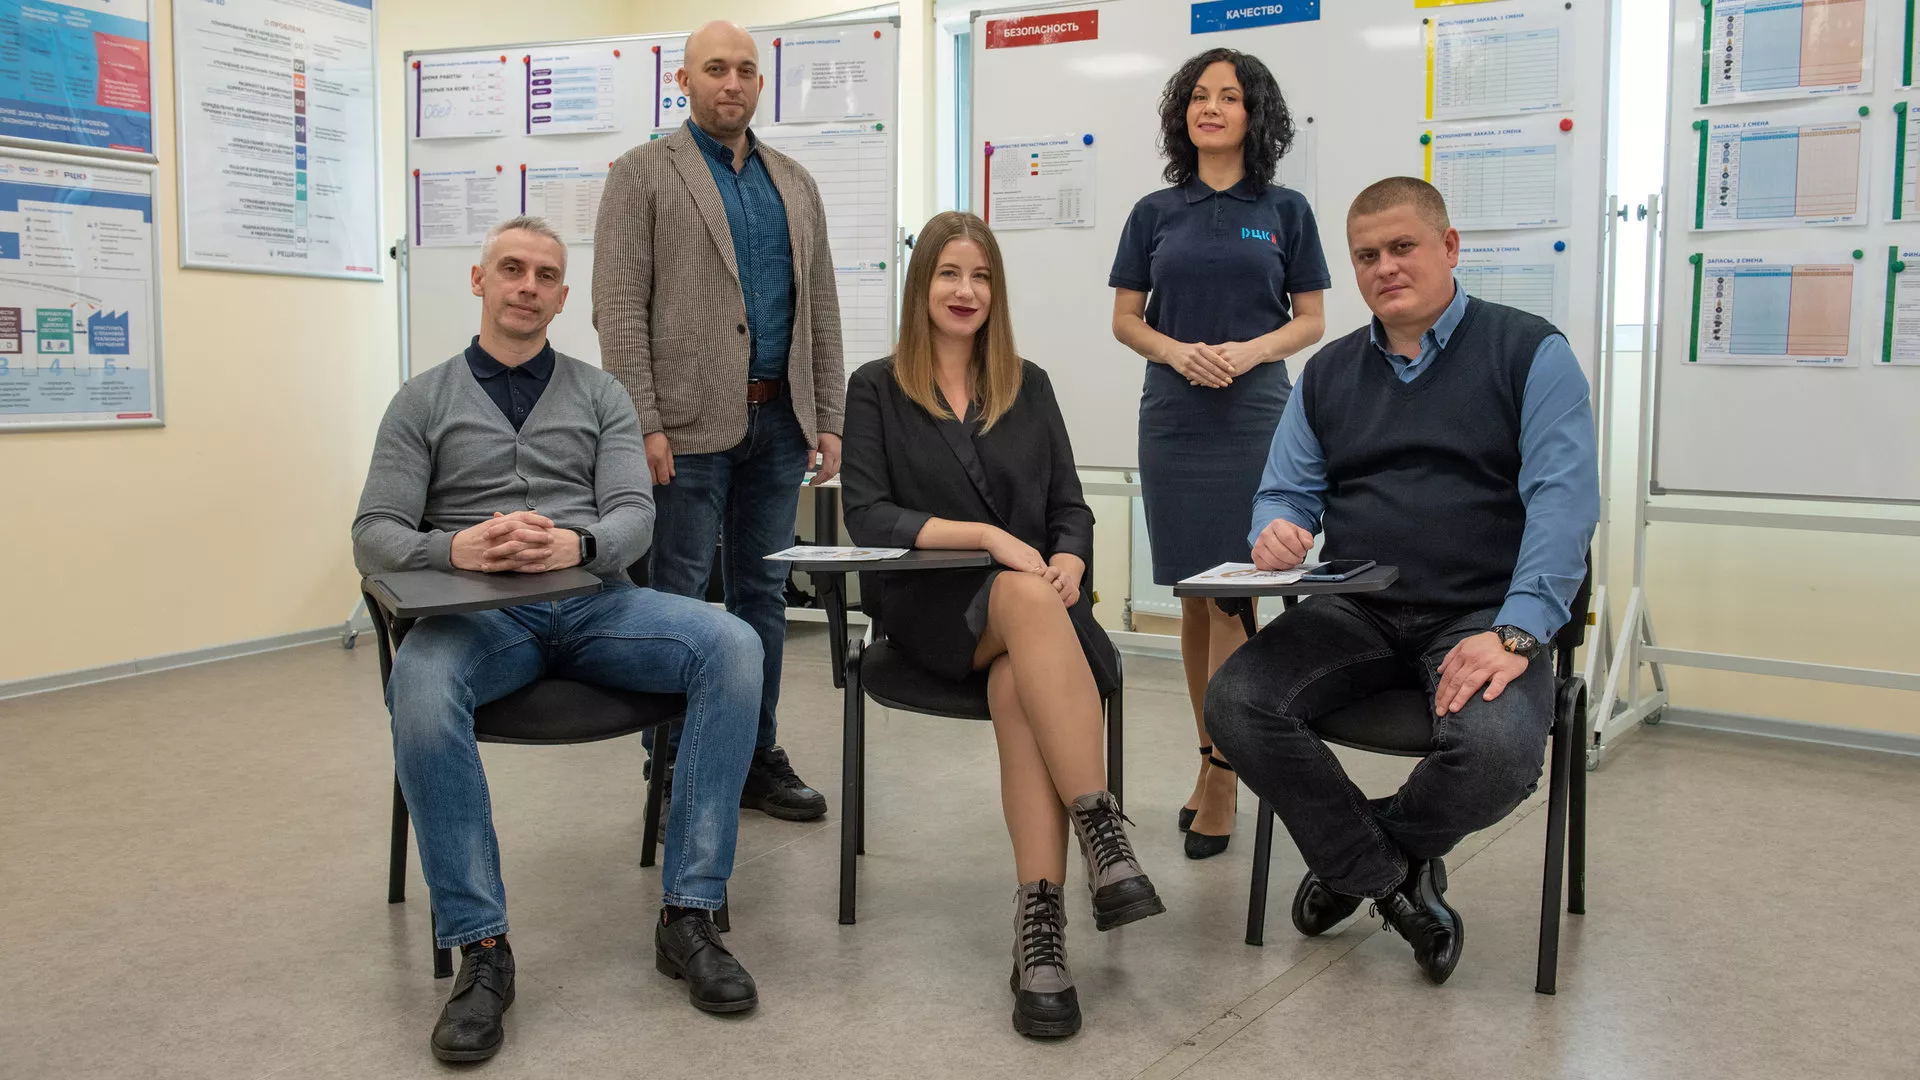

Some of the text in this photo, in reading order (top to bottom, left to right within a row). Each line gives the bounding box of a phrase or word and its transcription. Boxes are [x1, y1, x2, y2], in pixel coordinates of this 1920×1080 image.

[1226, 4, 1283, 20] КАЧЕСТВО
[1004, 22, 1079, 38] БЕЗОПАСНОСТЬ
[1435, 132, 1472, 140] ИСПОЛНЕНИЕ
[277, 250, 308, 259] РЕШЕНИЕ
[49, 358, 61, 377] 4
[104, 358, 116, 377] 5
